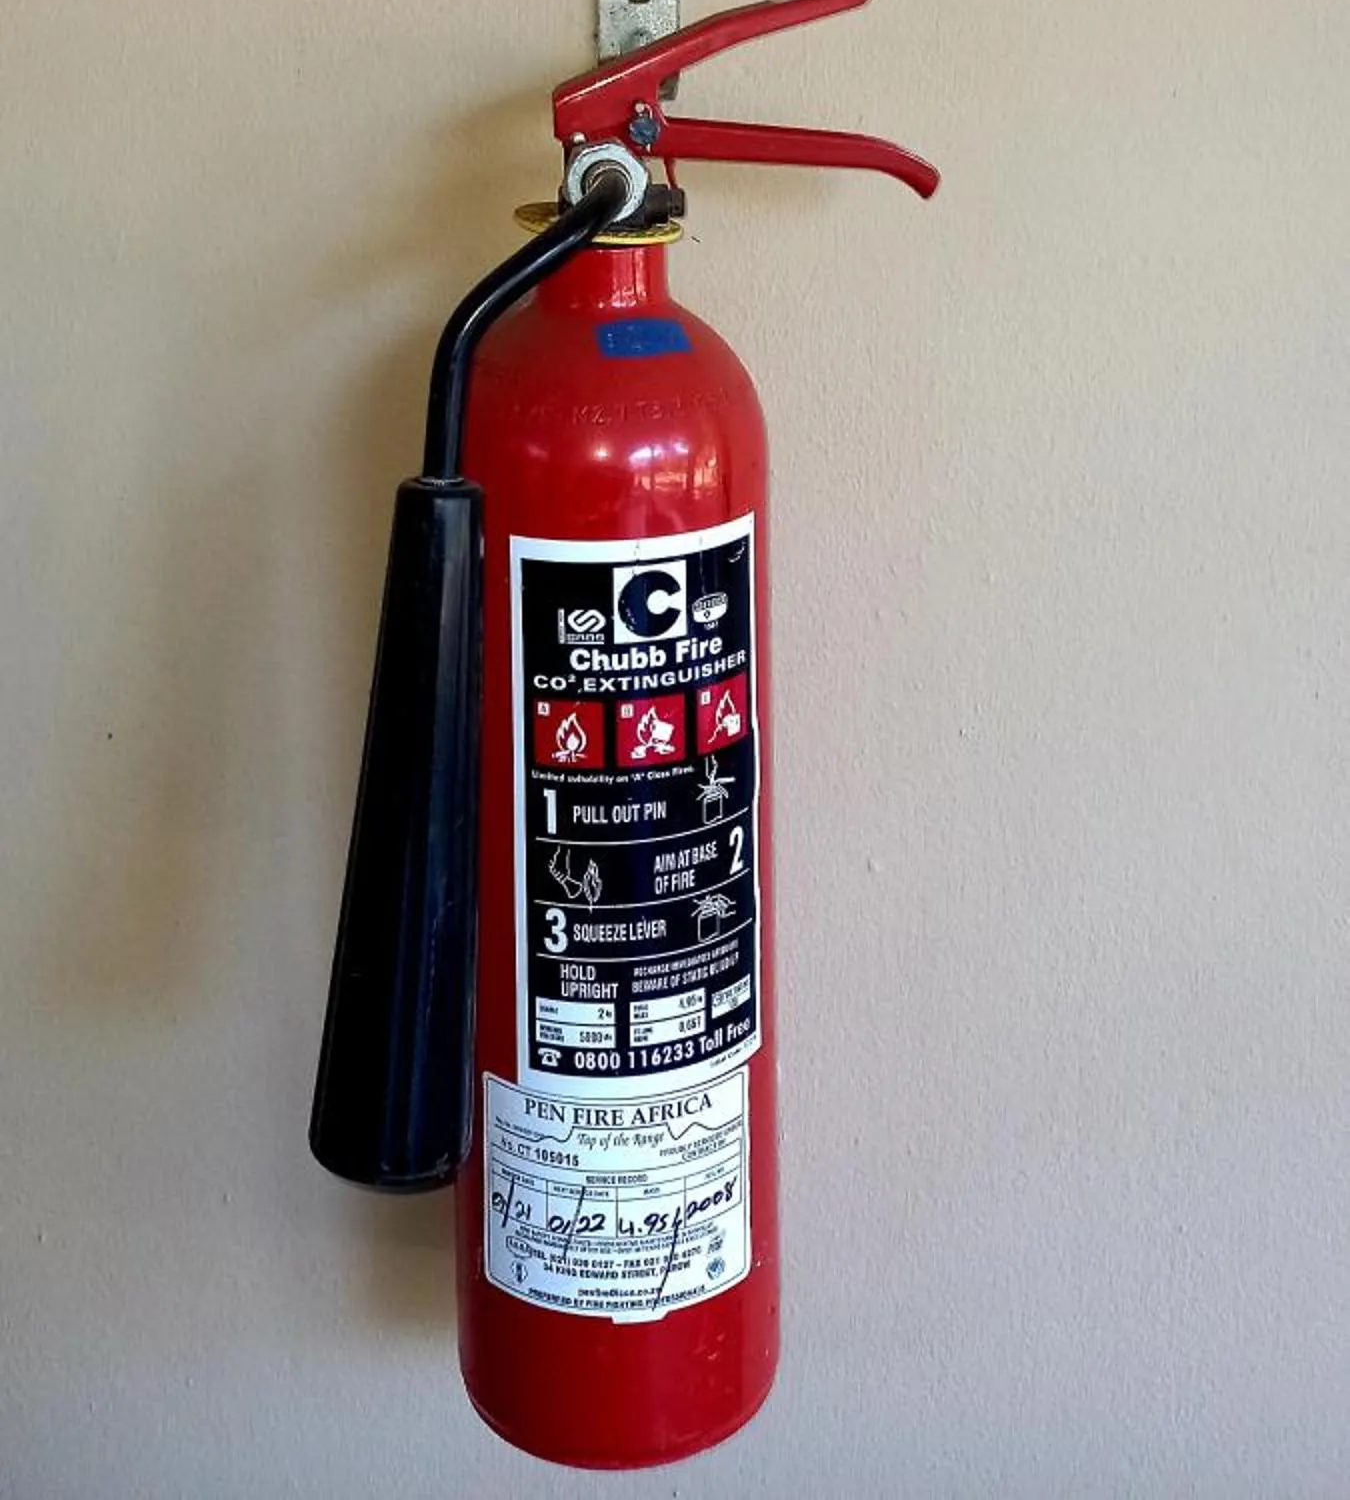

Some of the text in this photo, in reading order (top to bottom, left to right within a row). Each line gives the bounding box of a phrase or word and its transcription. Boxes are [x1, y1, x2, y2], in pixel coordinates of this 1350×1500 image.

[617, 569, 683, 638] C
[570, 636, 723, 671] Chubb Fire
[583, 649, 747, 692] EXTINGUISHER
[543, 788, 557, 834] 1
[573, 801, 667, 824] PULL OUT PIN
[654, 841, 718, 874] AIM AT BASE
[728, 826, 744, 875] 2
[655, 869, 696, 895] OF FIRE
[544, 907, 568, 953] 3
[573, 919, 667, 943] SQUEEZE LEVER
[560, 963, 596, 981] HOLD
[632, 976, 668, 994] BEWARE
[670, 974, 681, 988] OF
[561, 981, 619, 999] UPRIGHT
[575, 1052, 621, 1069] 0800
[627, 1040, 695, 1068] 116233
[699, 1027, 723, 1054] Toll
[727, 1018, 751, 1042] Free
[524, 1098, 567, 1123] PEN
[573, 1107, 625, 1127] FIRE
[631, 1093, 712, 1124] AFRICA
[577, 1131, 665, 1151] Top of the Range
